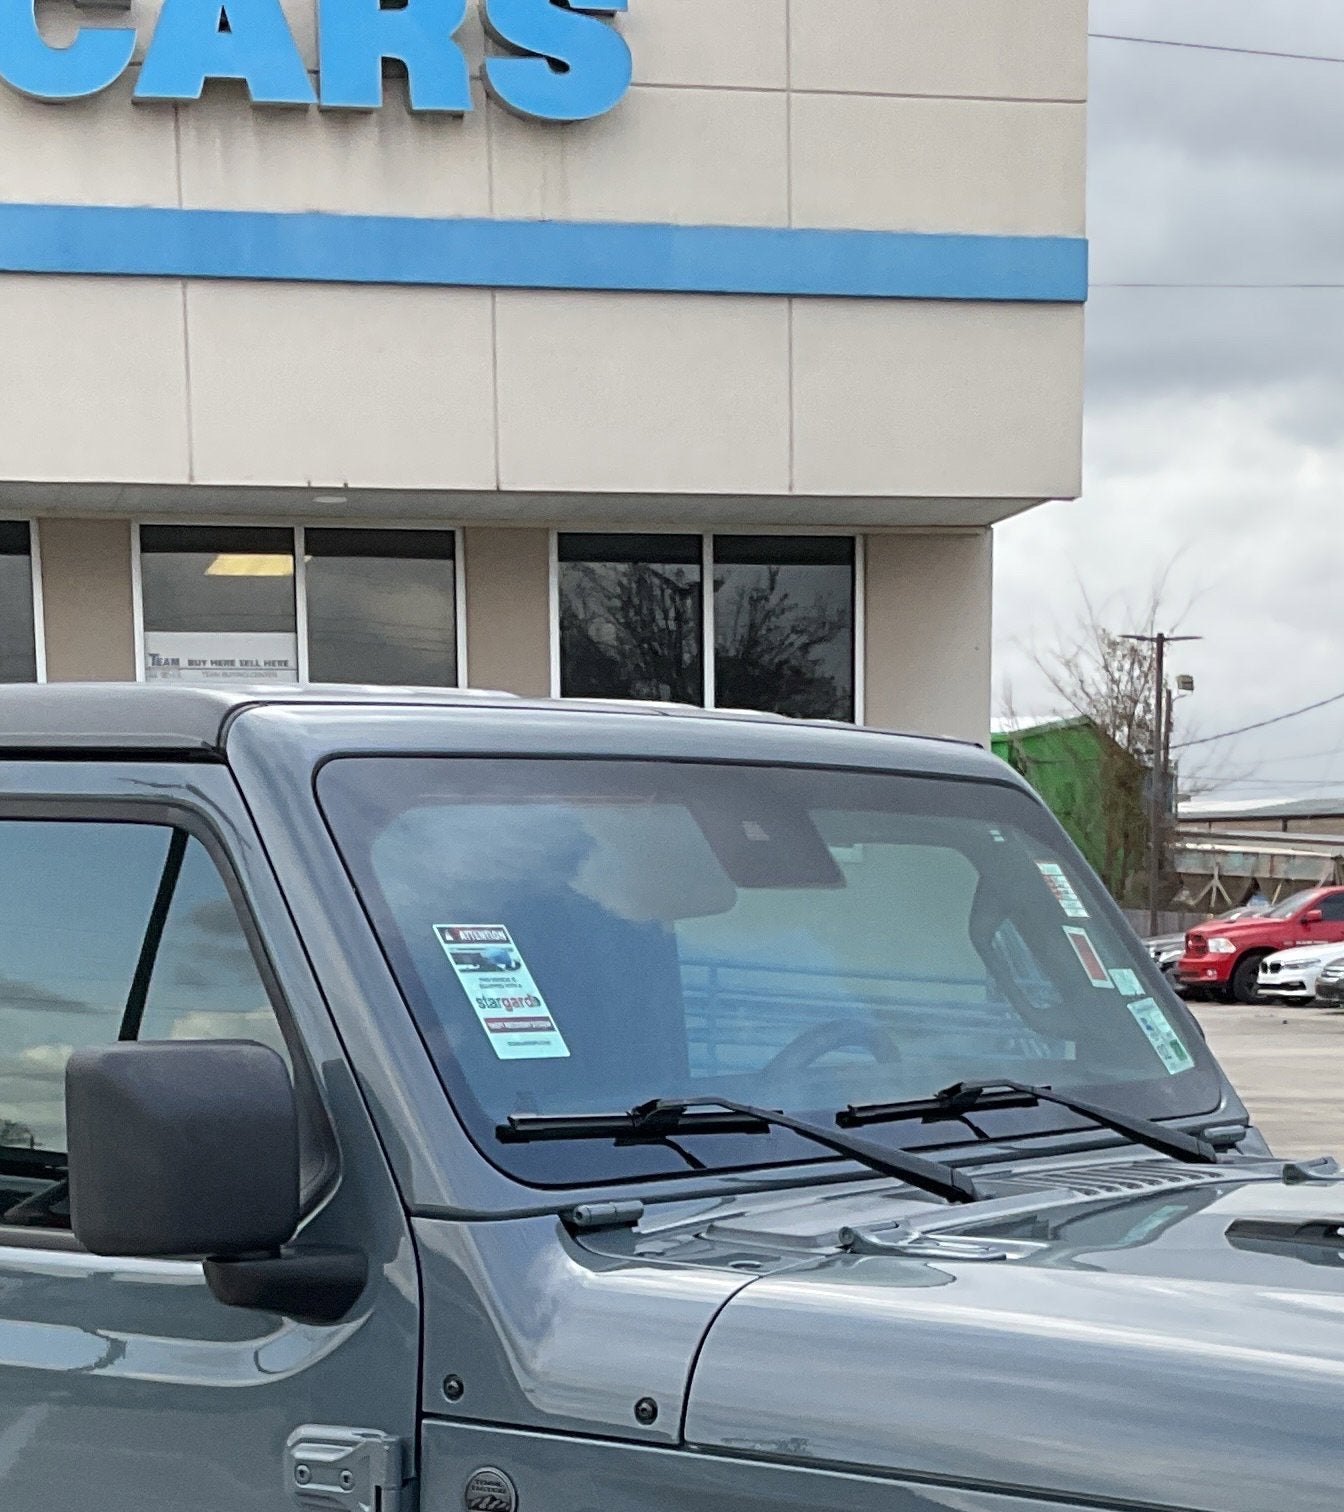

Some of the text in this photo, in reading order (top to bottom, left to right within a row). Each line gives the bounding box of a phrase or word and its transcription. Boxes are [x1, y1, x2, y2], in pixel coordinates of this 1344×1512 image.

[187, 659, 207, 667] BUY
[210, 659, 236, 667] HERE
[239, 659, 261, 667] SELL
[263, 659, 289, 667] HERE
